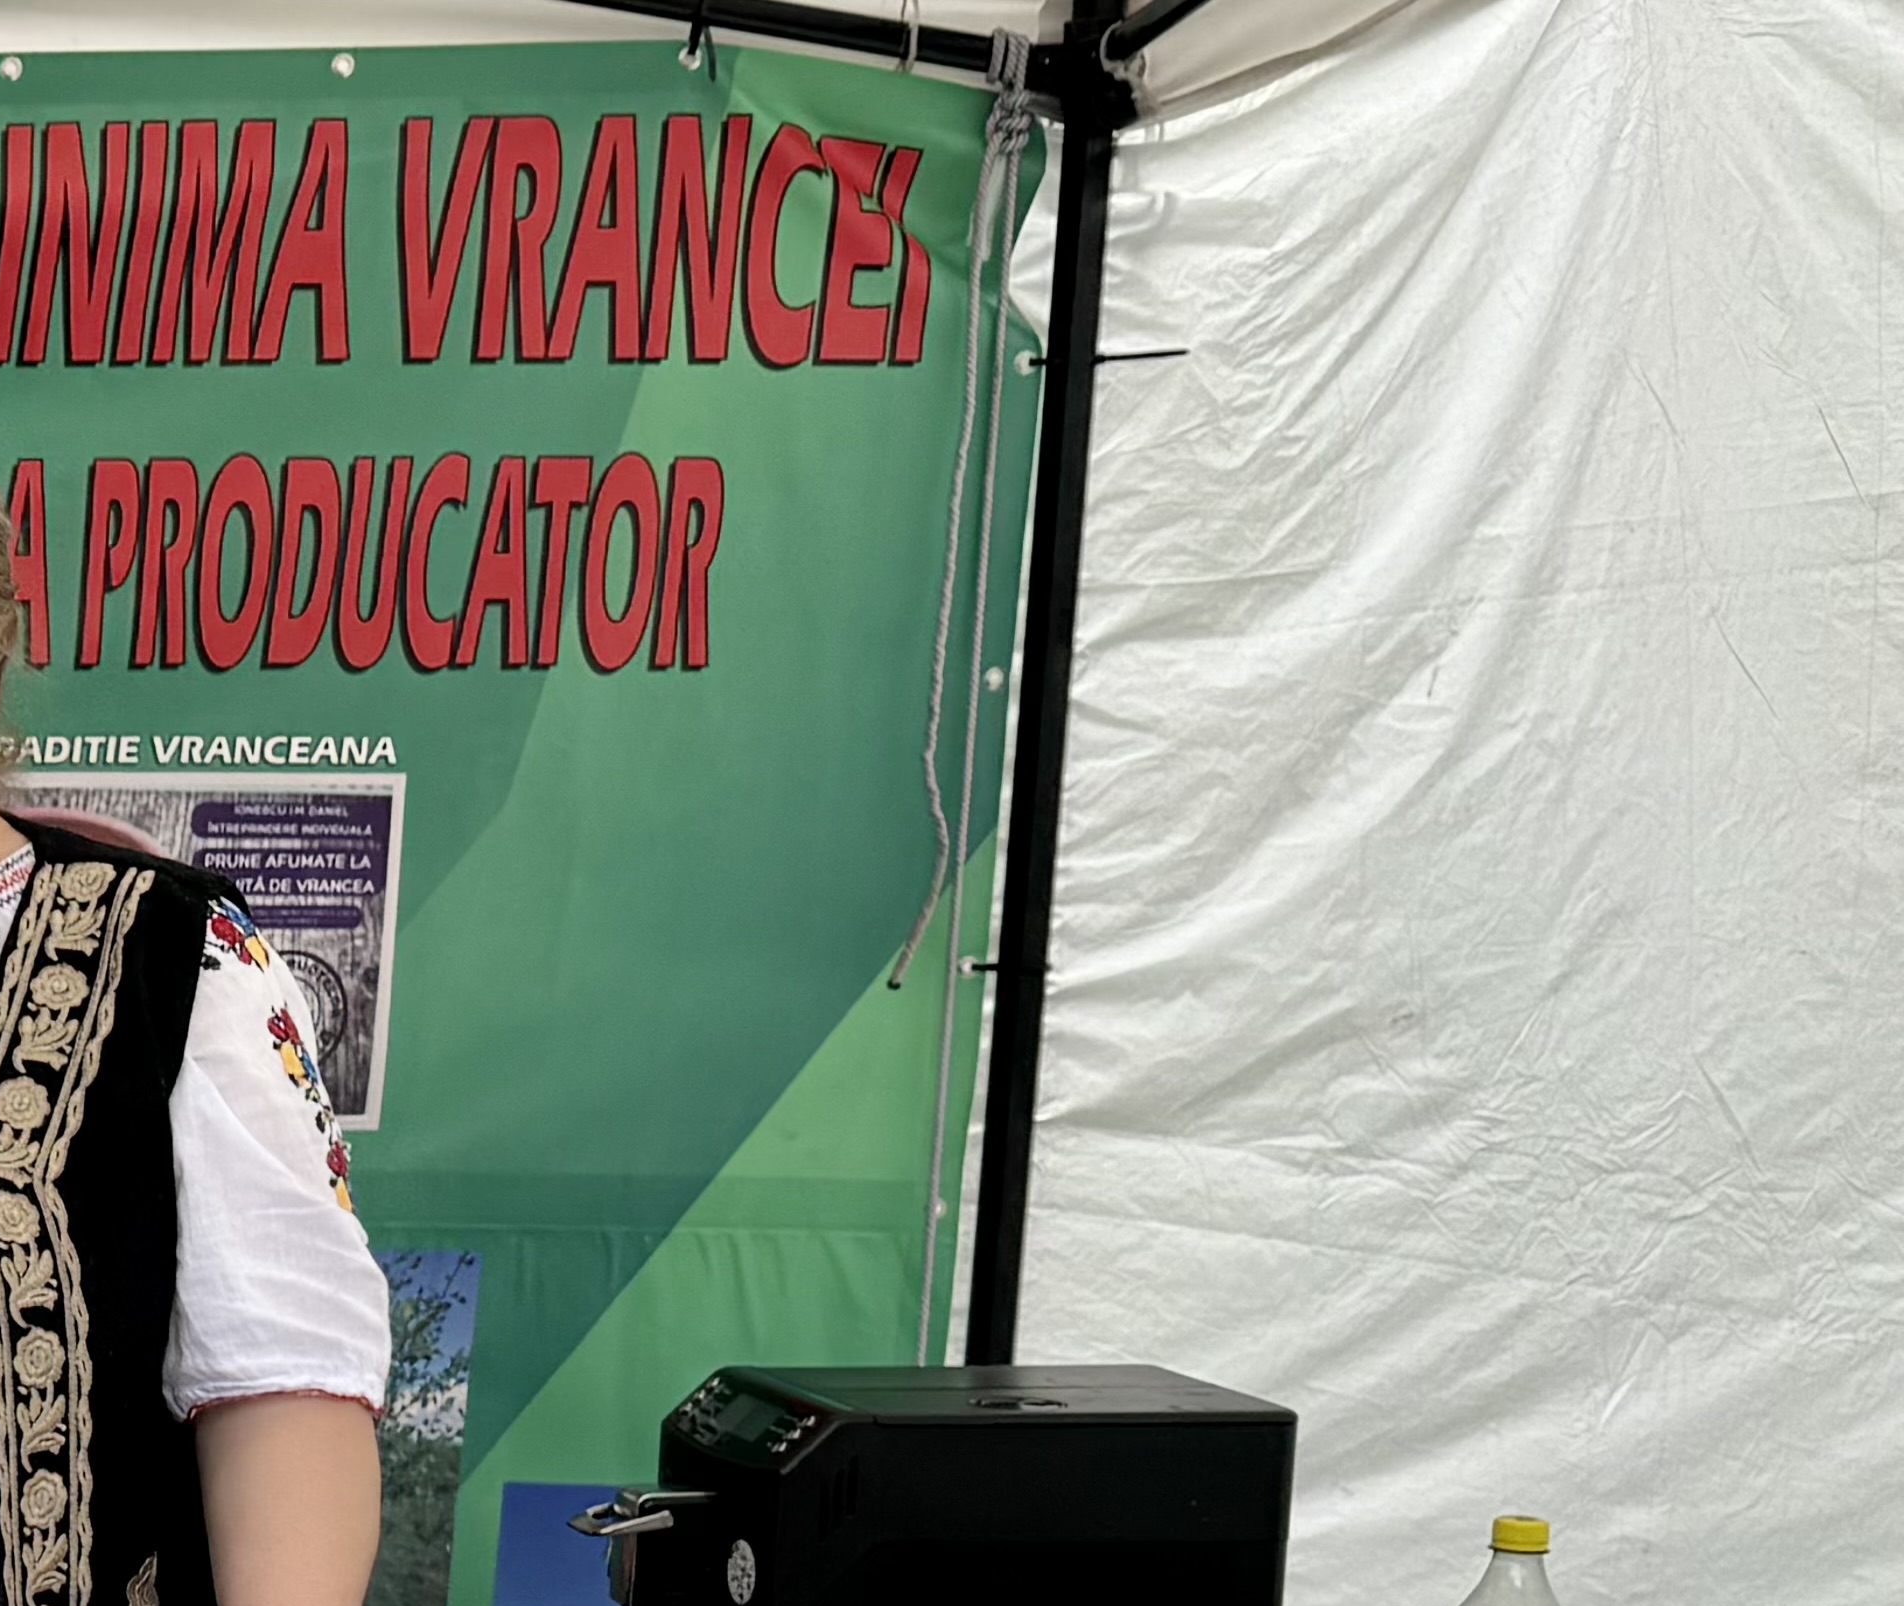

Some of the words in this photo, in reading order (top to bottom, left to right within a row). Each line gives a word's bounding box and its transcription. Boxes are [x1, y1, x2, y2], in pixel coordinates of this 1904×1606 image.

[399, 112, 931, 370] VRANCEI
[80, 452, 725, 672] PRODUCATOR
[154, 734, 398, 765] VRANCEANA
[308, 805, 349, 818] DANIEL
[204, 853, 261, 869] PRUNE
[265, 853, 345, 869] AFUMATE
[350, 853, 372, 869] LA
[269, 877, 292, 894] DE
[296, 878, 375, 894] VRANCEA
